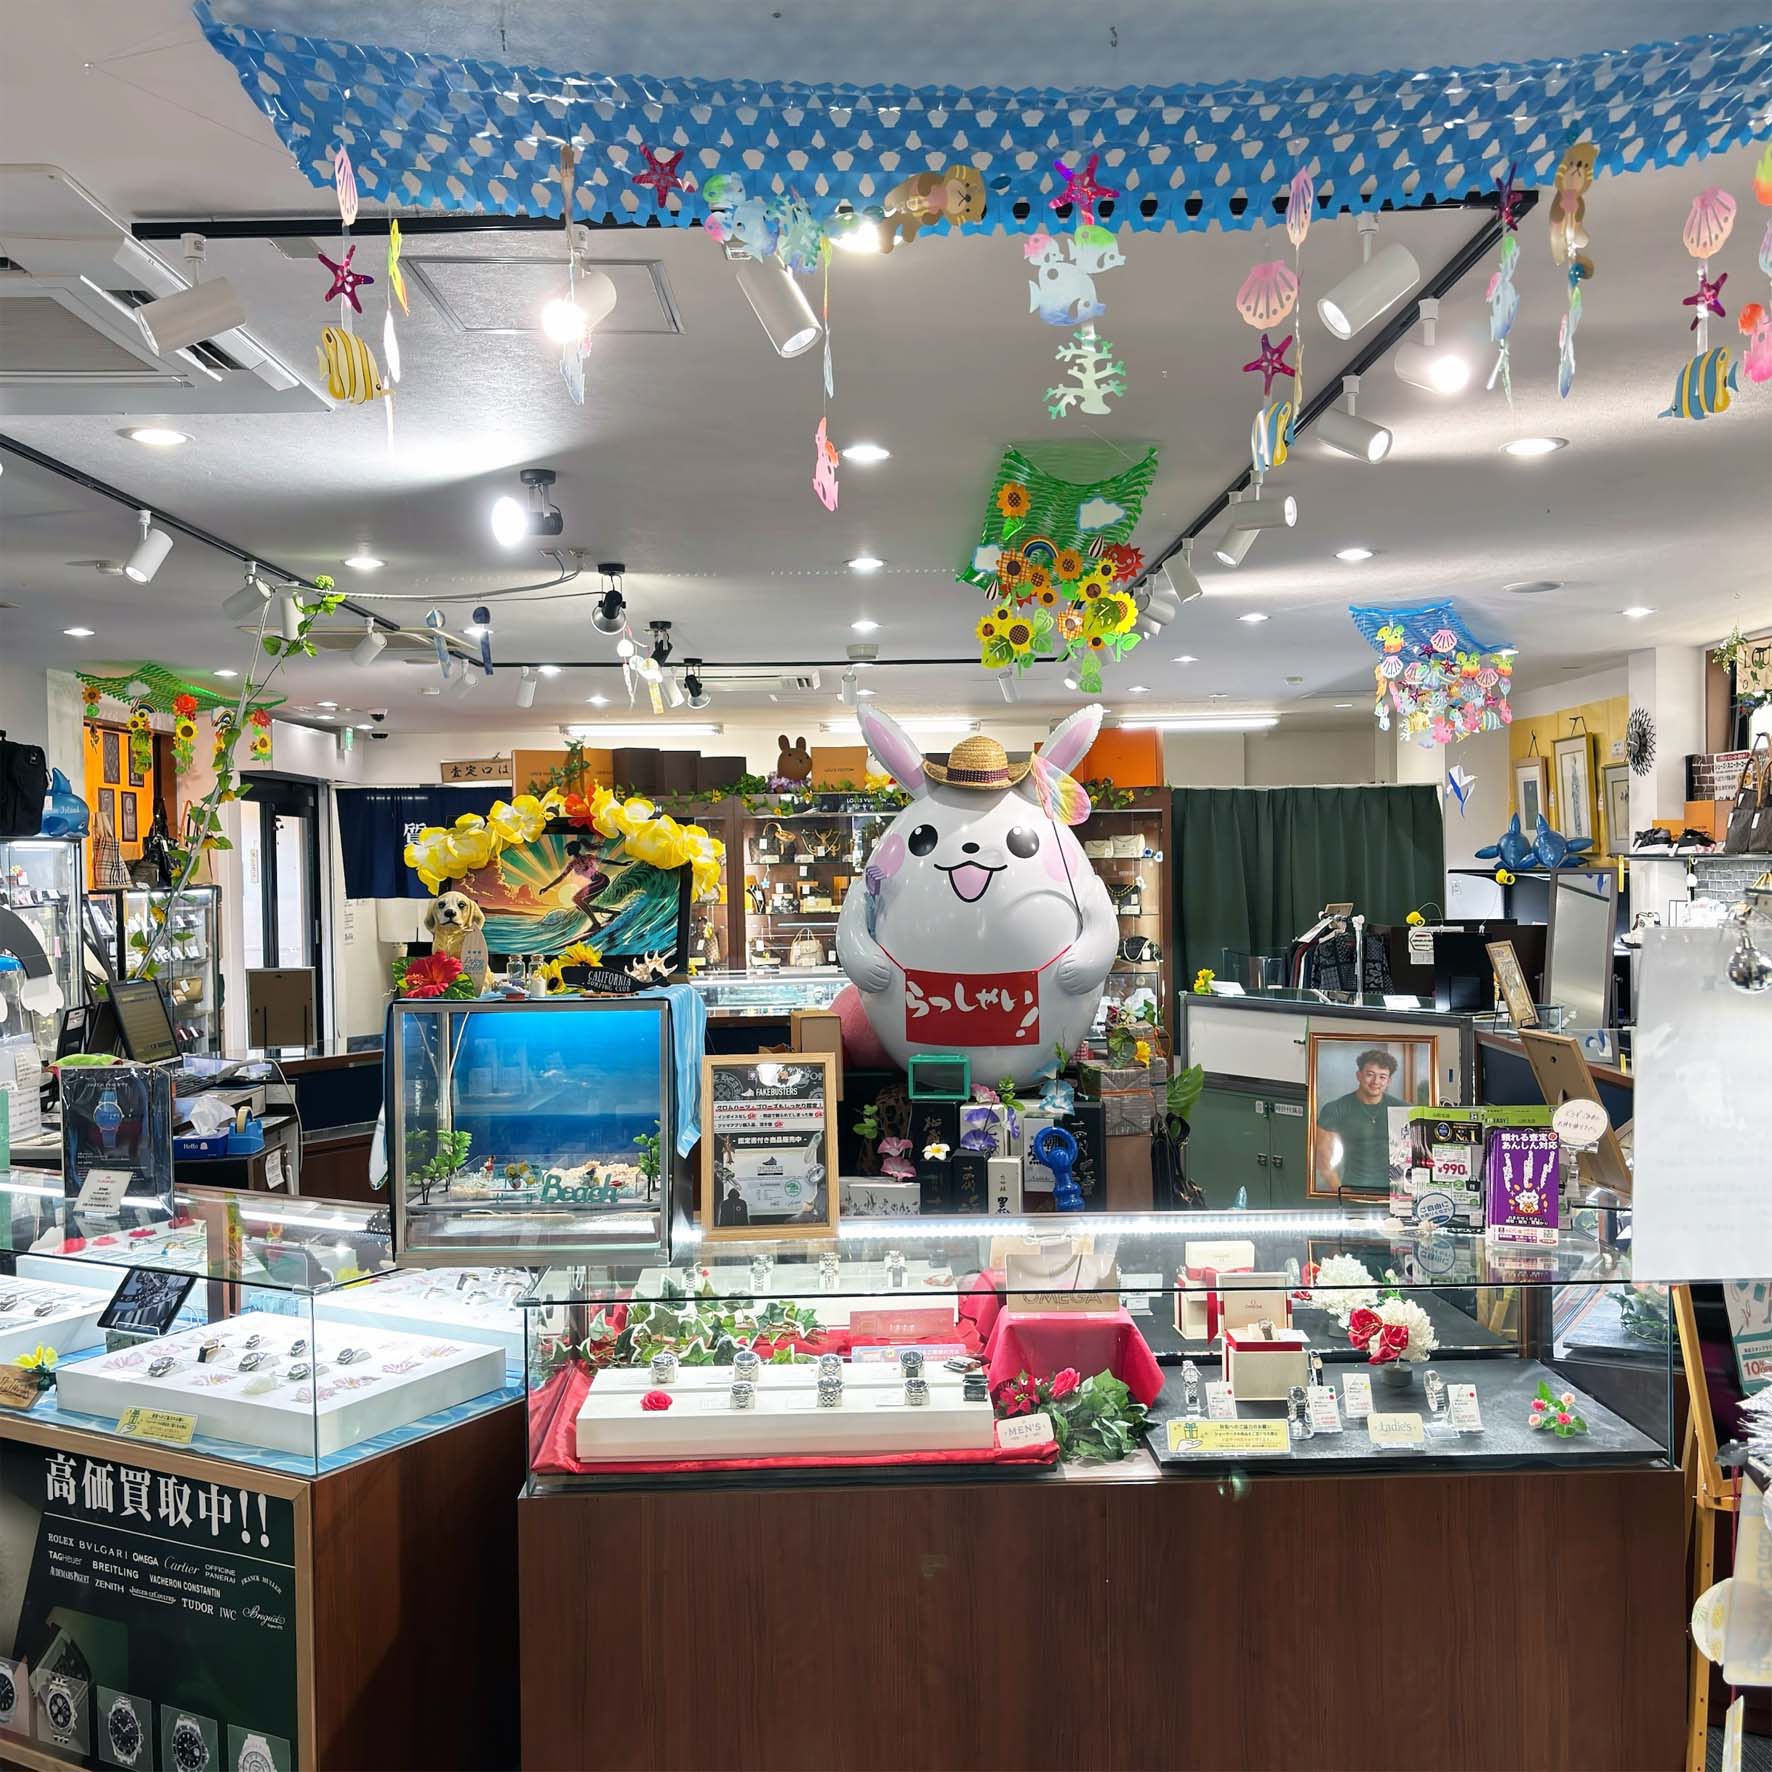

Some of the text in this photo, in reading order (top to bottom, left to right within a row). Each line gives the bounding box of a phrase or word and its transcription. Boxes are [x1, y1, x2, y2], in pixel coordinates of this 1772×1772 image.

[587, 970, 632, 987] CALIFORNIA
[755, 1087, 798, 1097] FAKEBUSTERS
[1502, 1141, 1558, 1151] あんしん対応
[540, 1173, 618, 1204] Beach
[1008, 1422, 1042, 1436] MEN'S
[45, 1452, 270, 1549] 高価買取中!!
[48, 1532, 200, 1576] ROLEX BVLGARI OMEGA Cartier
[92, 1560, 139, 1580] BREITLING
[204, 1563, 236, 1577] OFFICINE
[204, 1571, 236, 1585] PANERAI
[95, 1579, 125, 1593] ZENITH
[149, 1574, 221, 1599] VACHERON CONSTANTIN
[181, 1597, 237, 1621] TUDOR IWC
